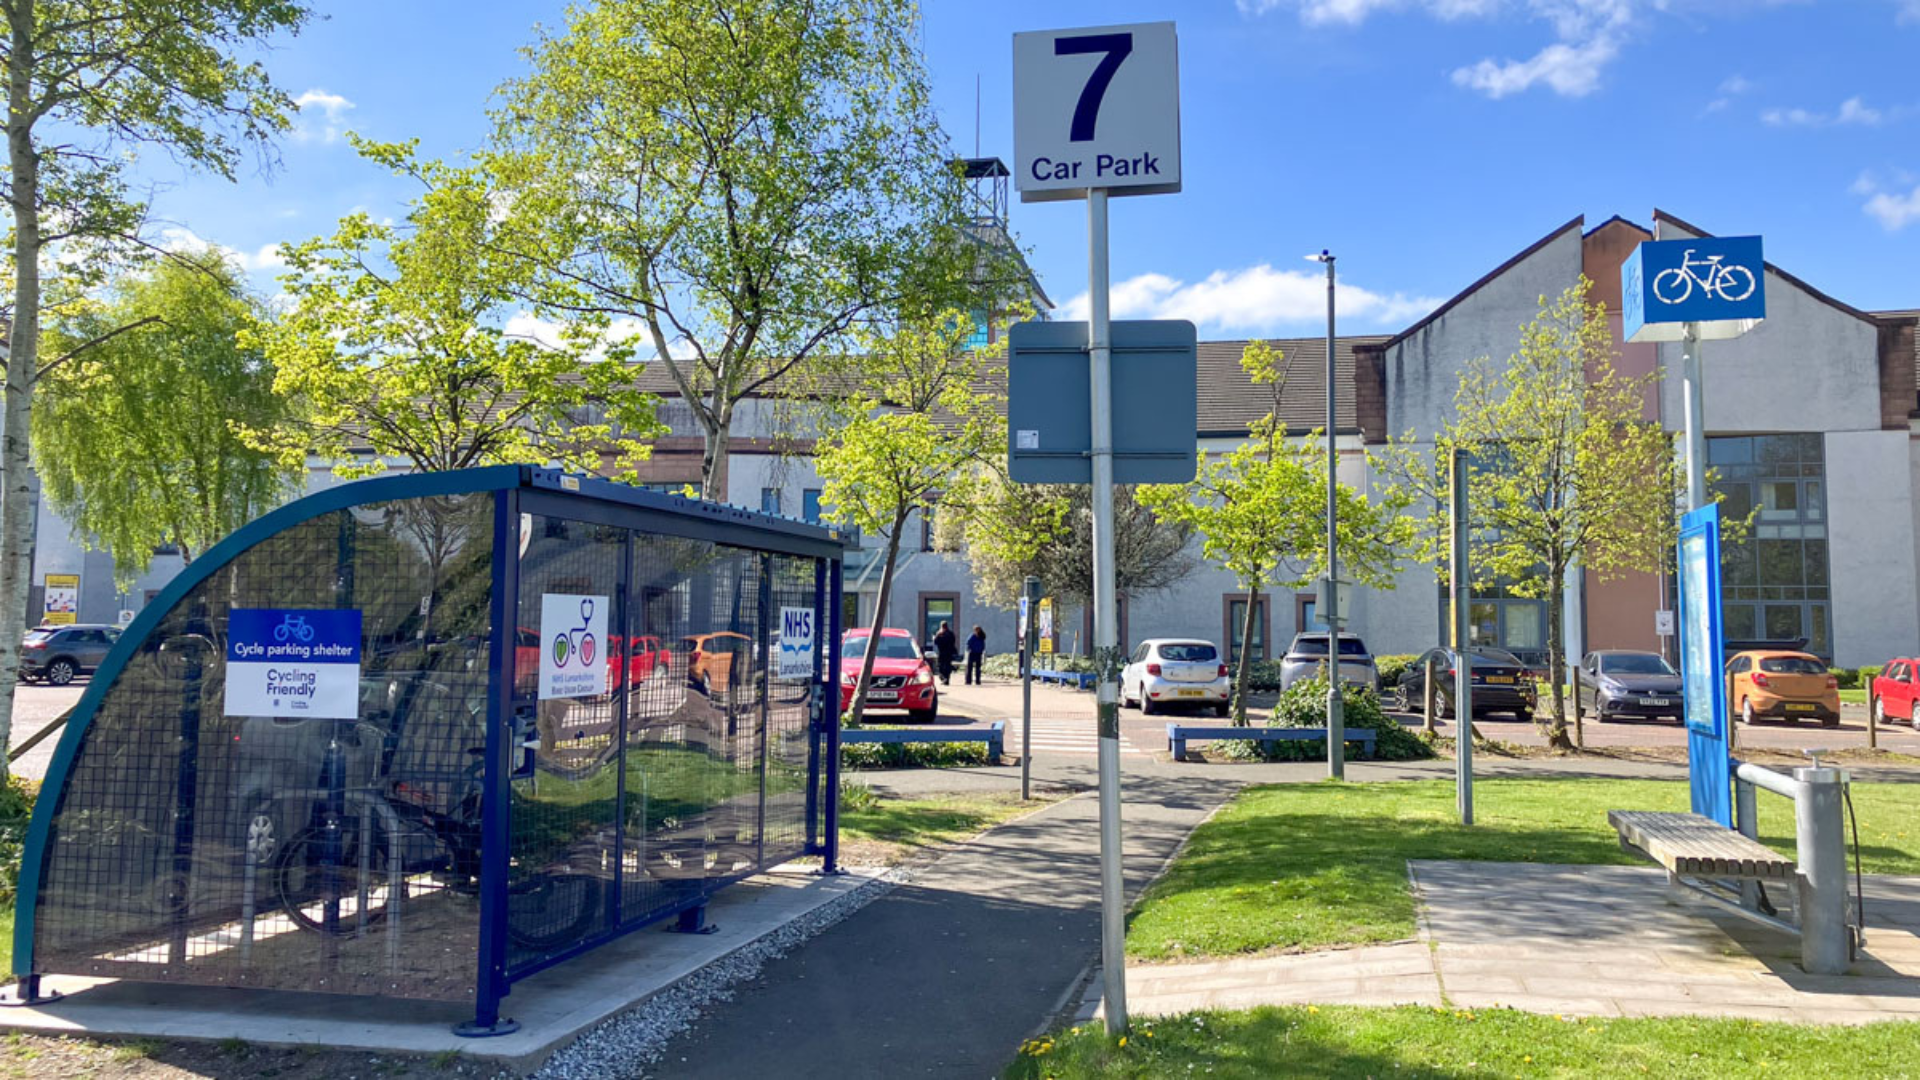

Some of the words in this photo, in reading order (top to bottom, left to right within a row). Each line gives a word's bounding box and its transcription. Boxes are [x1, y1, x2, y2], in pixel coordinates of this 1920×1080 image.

[1054, 32, 1133, 143] 7
[1031, 157, 1082, 181] Car
[1096, 151, 1160, 177] Park
[784, 610, 811, 638] NHS
[234, 642, 265, 657] Cycle
[267, 643, 310, 658] parking
[313, 643, 353, 656] shelter
[266, 668, 316, 685] Cycling
[266, 682, 316, 698] Friendly
